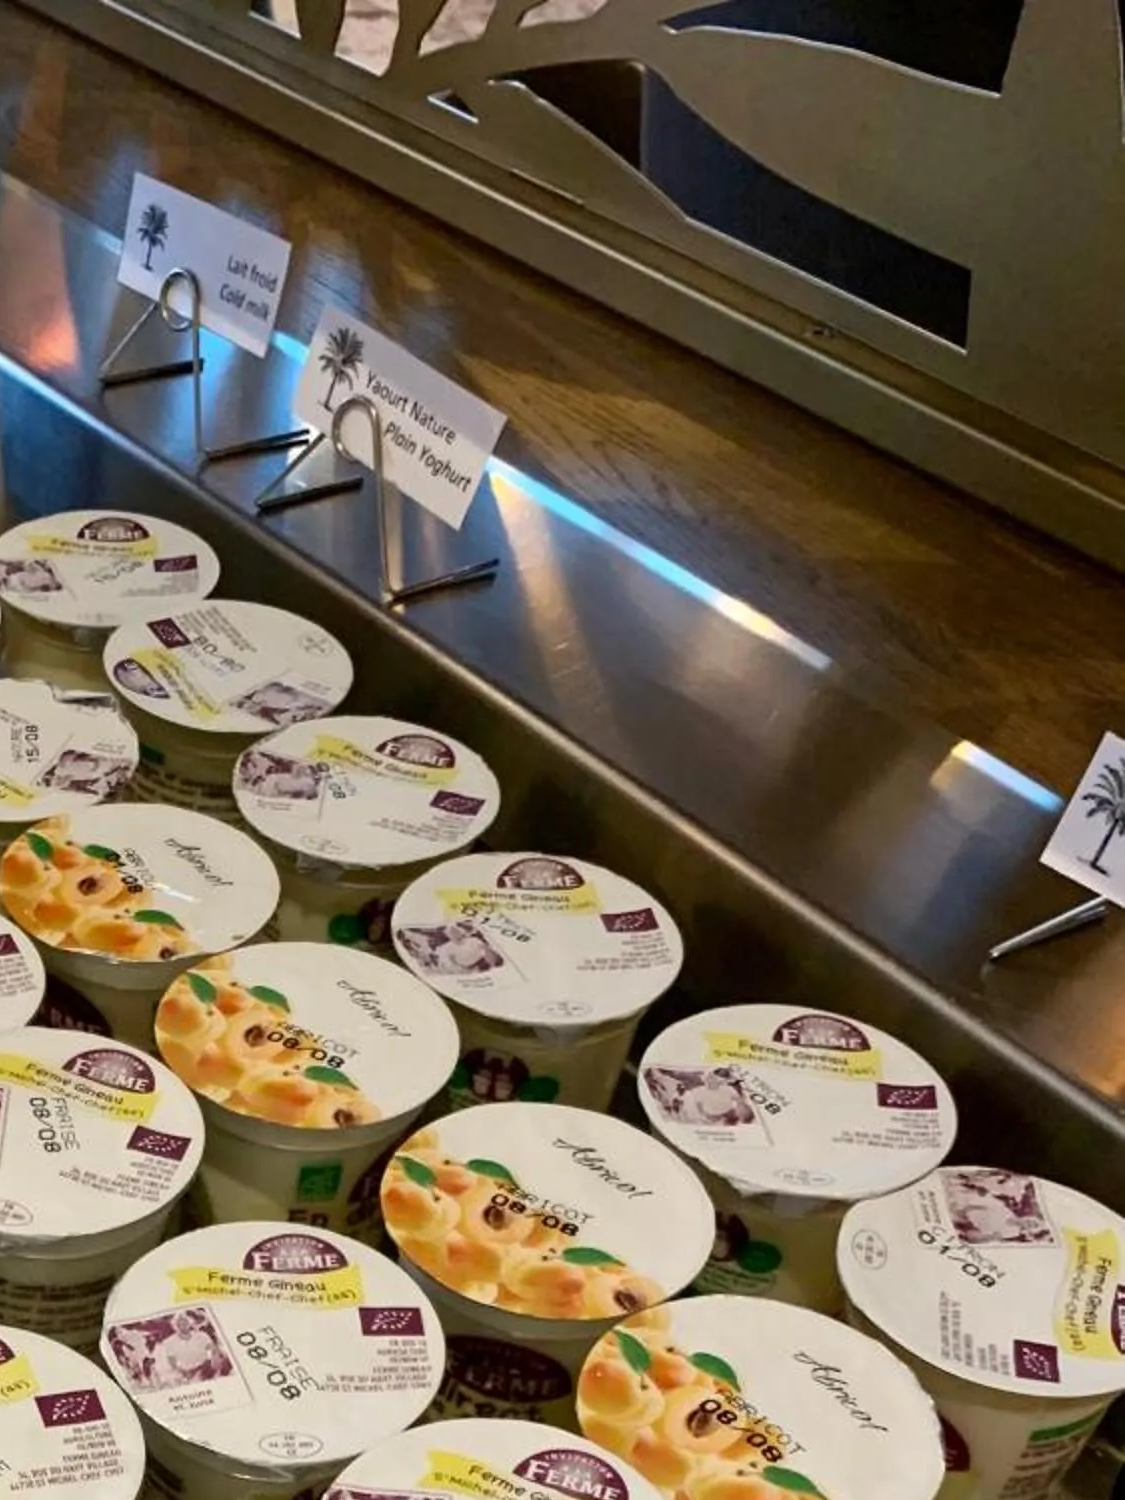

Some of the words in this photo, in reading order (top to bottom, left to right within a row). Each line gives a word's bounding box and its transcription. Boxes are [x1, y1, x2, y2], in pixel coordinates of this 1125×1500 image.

[227, 254, 248, 275] Lait
[248, 261, 278, 293] froid
[220, 284, 245, 306] Cold
[246, 294, 270, 320] milk
[365, 370, 410, 413] Yaourt
[411, 400, 456, 445] Nature
[384, 422, 418, 456] Plain
[419, 441, 471, 492] Yoghurt
[25, 724, 38, 764] 15/08
[500, 874, 580, 889] FERME
[337, 978, 411, 1038] Abricot
[267, 1028, 347, 1069] 08/08
[738, 1040, 790, 1060] Ferme
[781, 1028, 863, 1050] FERME
[25, 1062, 72, 1086] Ferme
[76, 1081, 124, 1105] Gineau
[73, 1059, 149, 1090] FERME
[29, 1097, 61, 1154] 08/08
[552, 1138, 655, 1200] Abricot
[490, 1193, 580, 1237] 08/08
[252, 1252, 340, 1271] FERME
[918, 1229, 997, 1289] 01/08
[1096, 1256, 1113, 1296] Ferme
[208, 1271, 262, 1288] Ferme
[268, 1277, 327, 1292] Gineau
[236, 1331, 302, 1400] 08/08
[258, 1325, 317, 1392] FRAISE
[793, 1352, 888, 1434] Abricot
[700, 1399, 783, 1462] 08/08
[468, 1463, 530, 1497] Ferme
